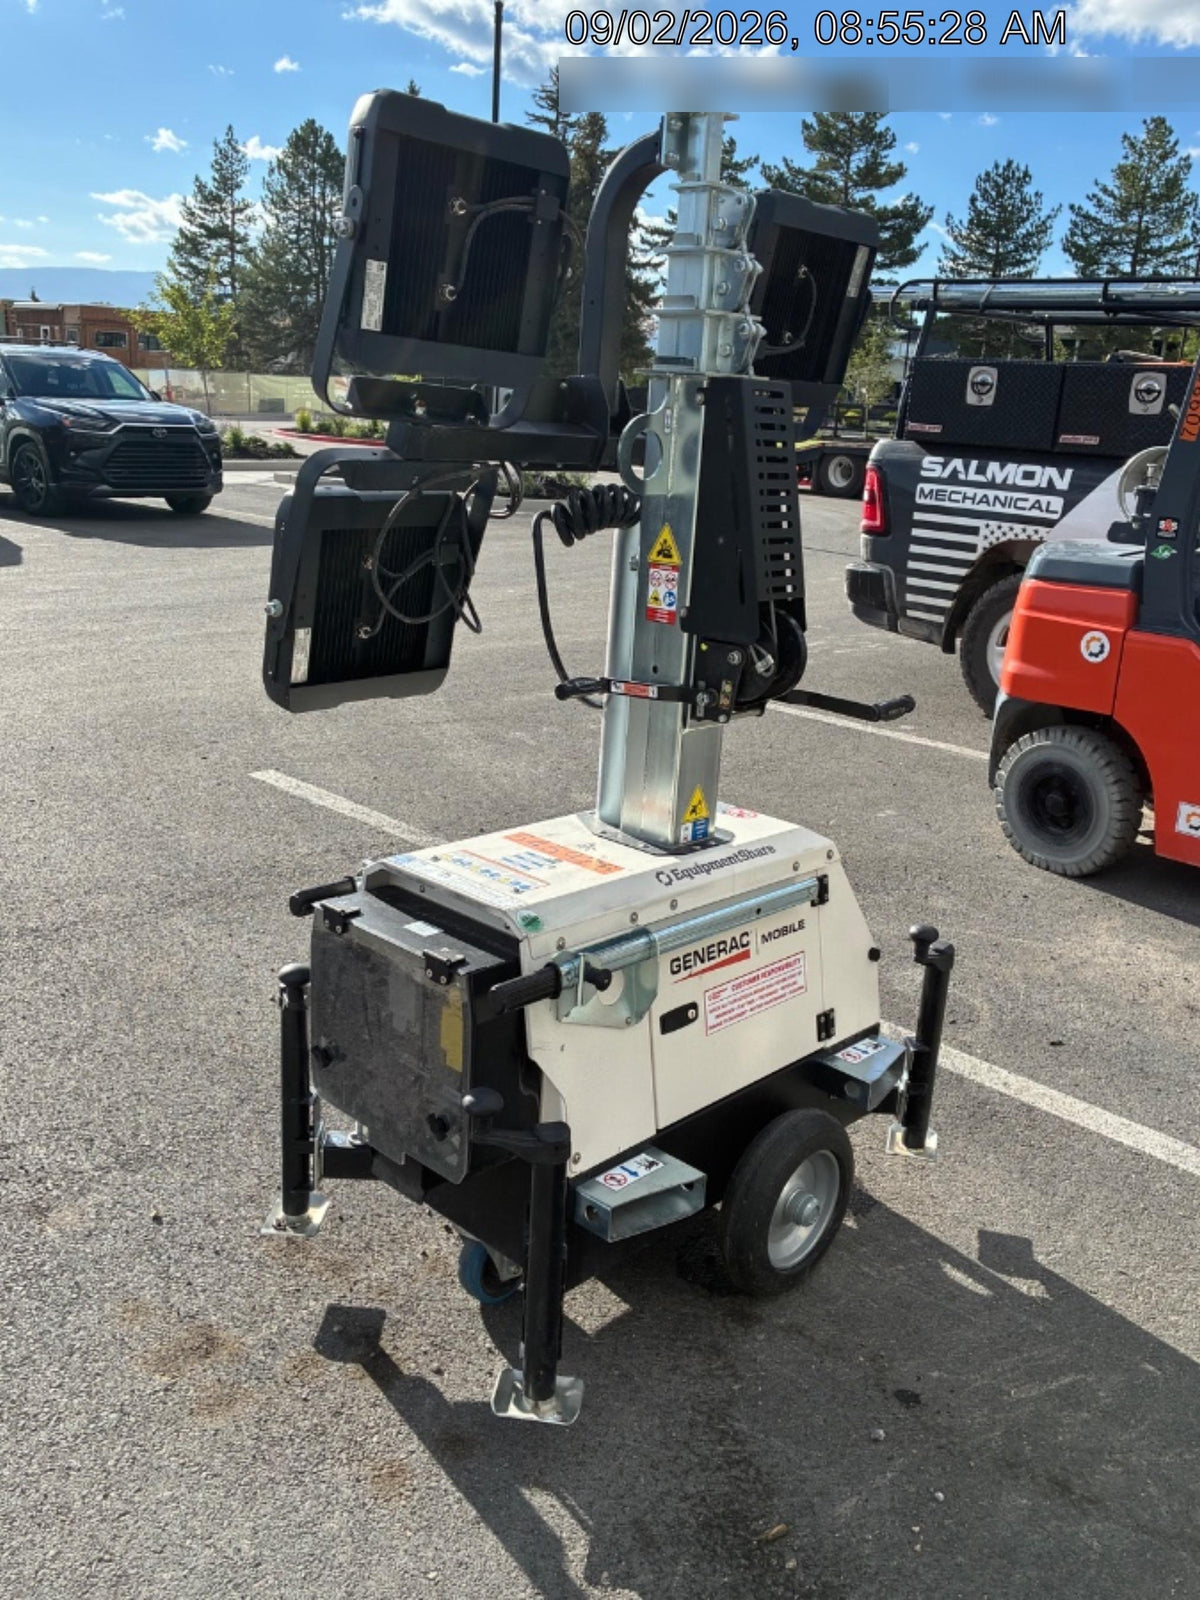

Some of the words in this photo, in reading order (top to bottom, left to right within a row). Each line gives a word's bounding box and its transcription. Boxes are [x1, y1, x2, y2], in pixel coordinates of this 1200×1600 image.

[920, 455, 1074, 491] SALMON
[918, 486, 1059, 515] MECHANICAL
[671, 845, 776, 880] EquipmentShare
[669, 931, 751, 975] GENERAC
[760, 919, 806, 945] MOBILE
